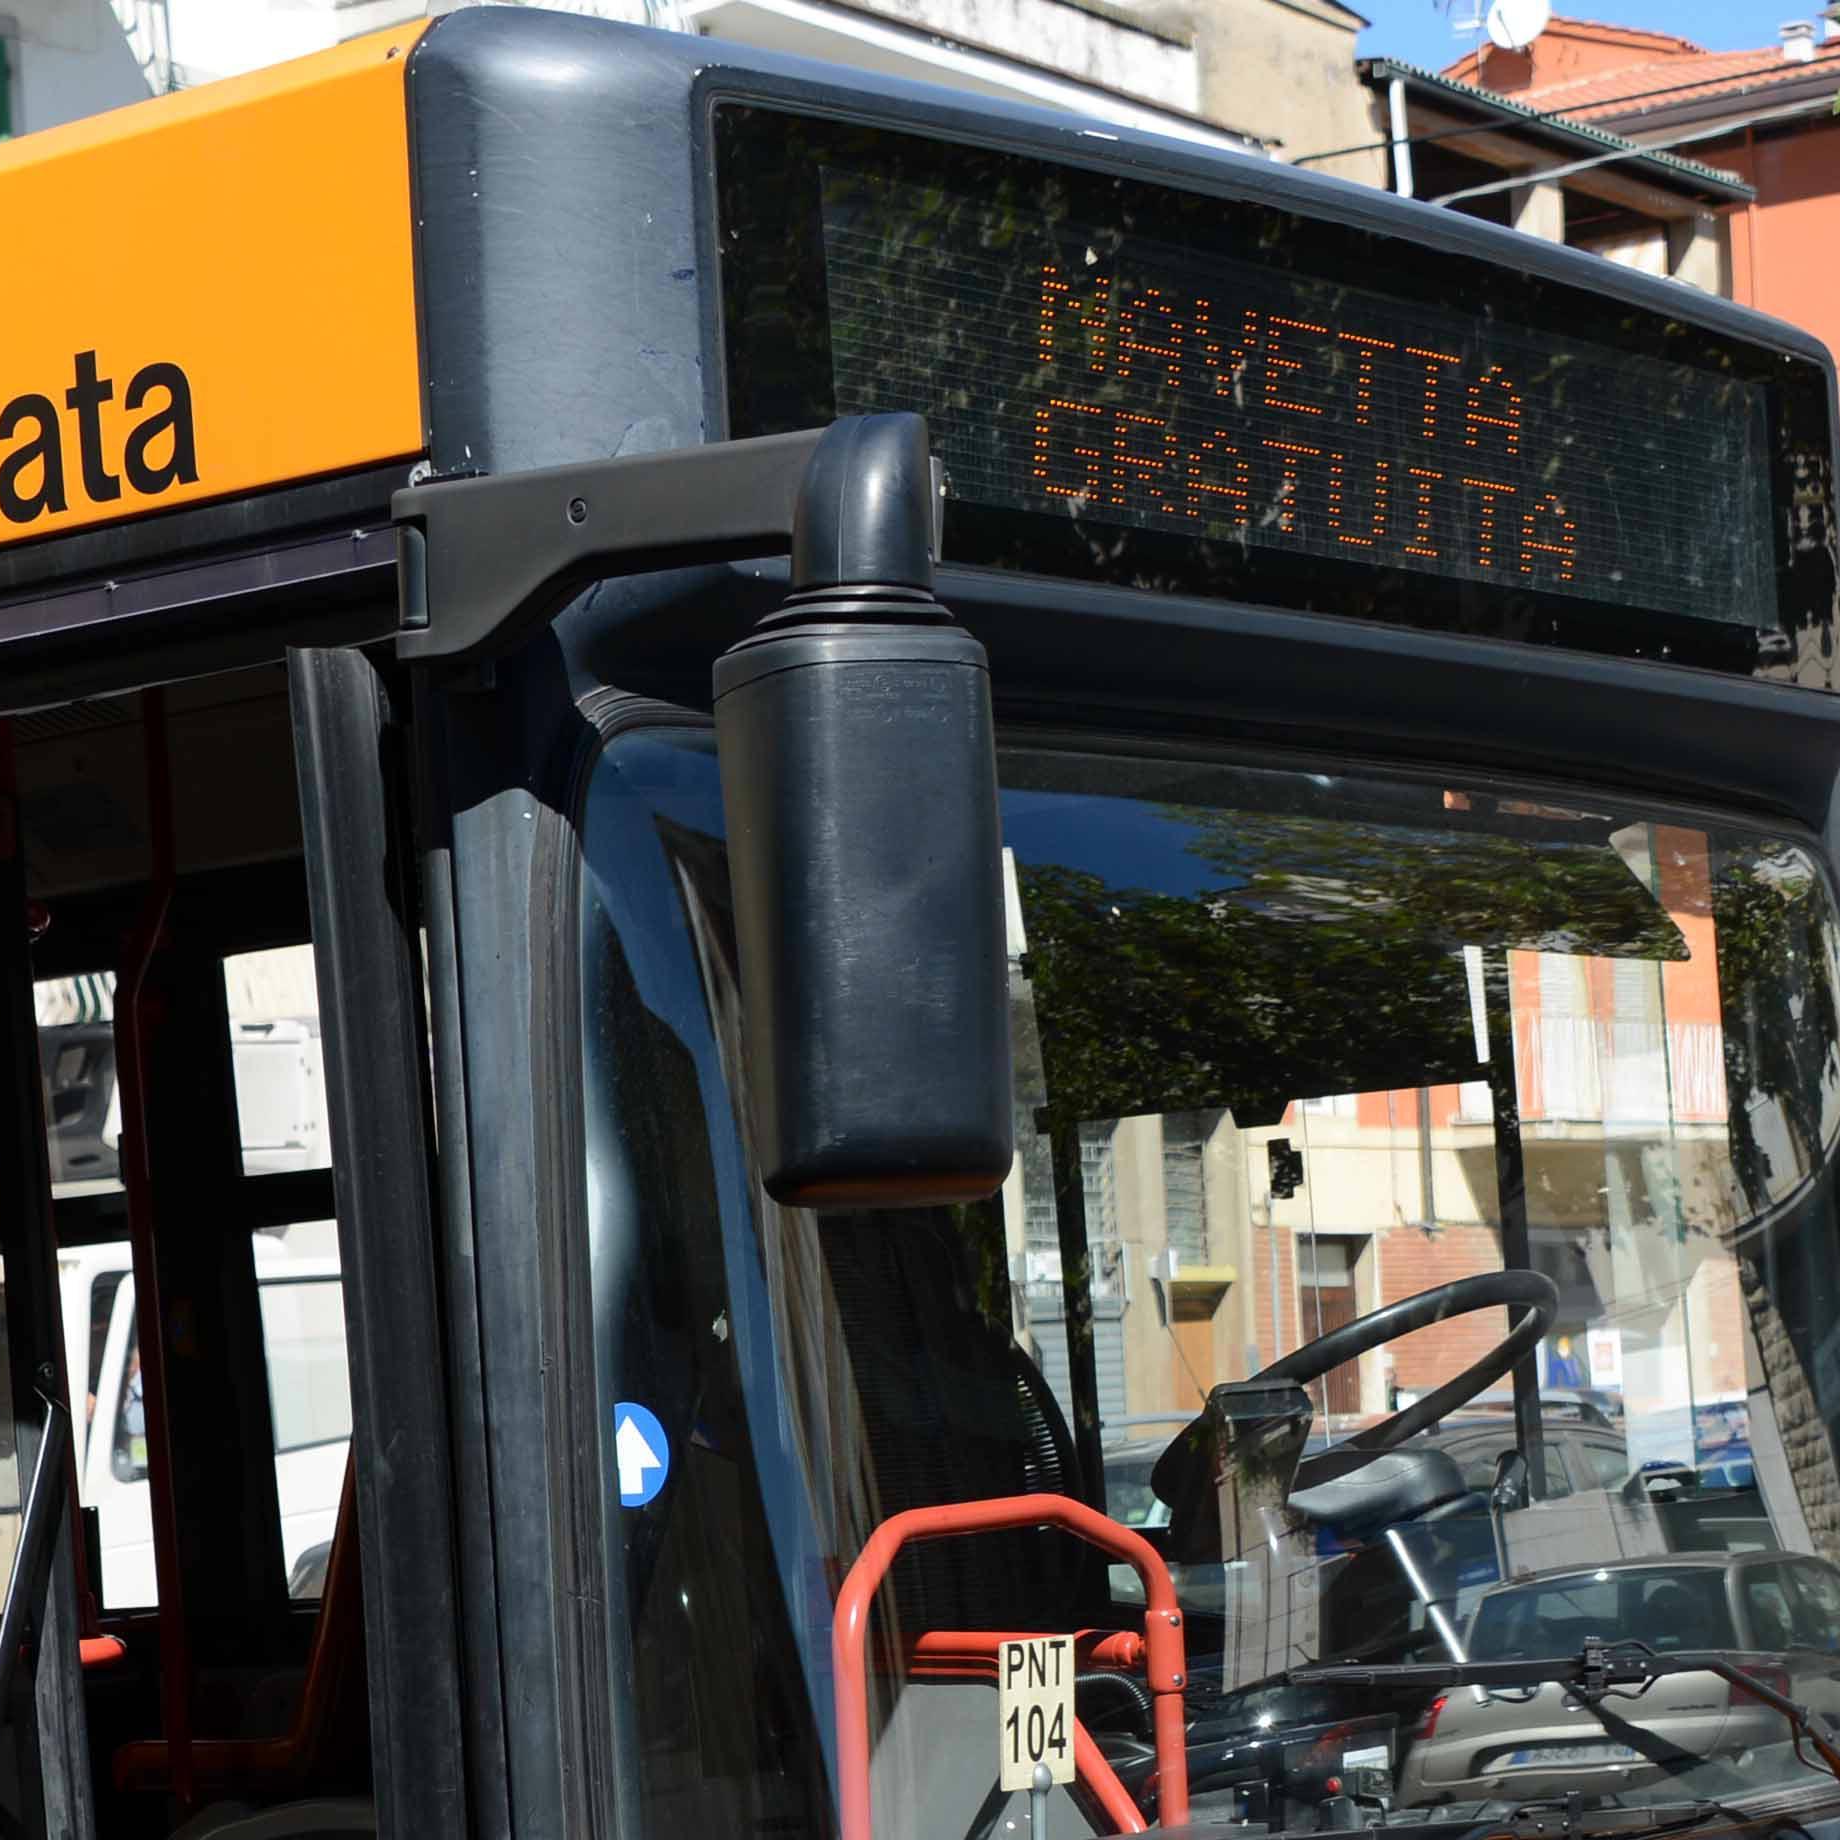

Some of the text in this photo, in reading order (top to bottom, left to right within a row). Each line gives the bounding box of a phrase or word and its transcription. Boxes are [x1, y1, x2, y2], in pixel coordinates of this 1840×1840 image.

[1033, 398, 1576, 580] GRATUITA
[1006, 1639, 1067, 1691] PNT
[1006, 1702, 1067, 1763] 104
